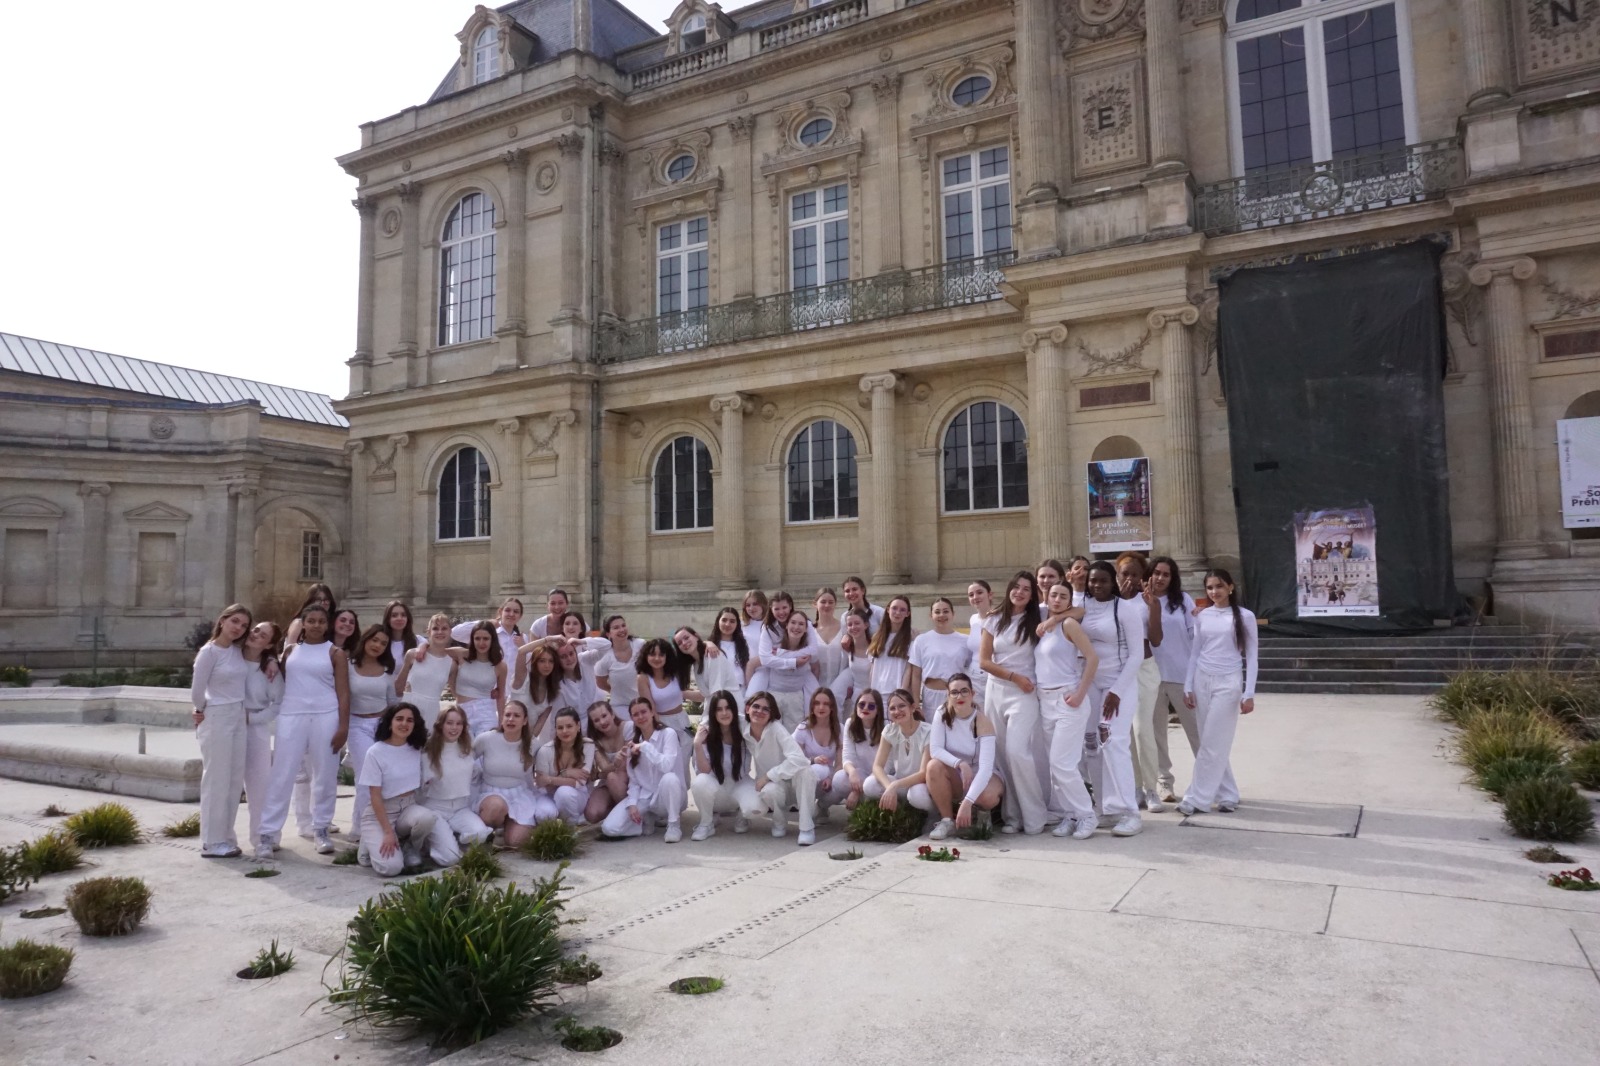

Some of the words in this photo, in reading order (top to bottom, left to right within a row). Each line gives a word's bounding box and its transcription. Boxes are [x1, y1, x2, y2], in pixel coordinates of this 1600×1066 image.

[1550, 0, 1579, 27] N
[1097, 105, 1115, 130] E
[1108, 520, 1129, 529] palais
